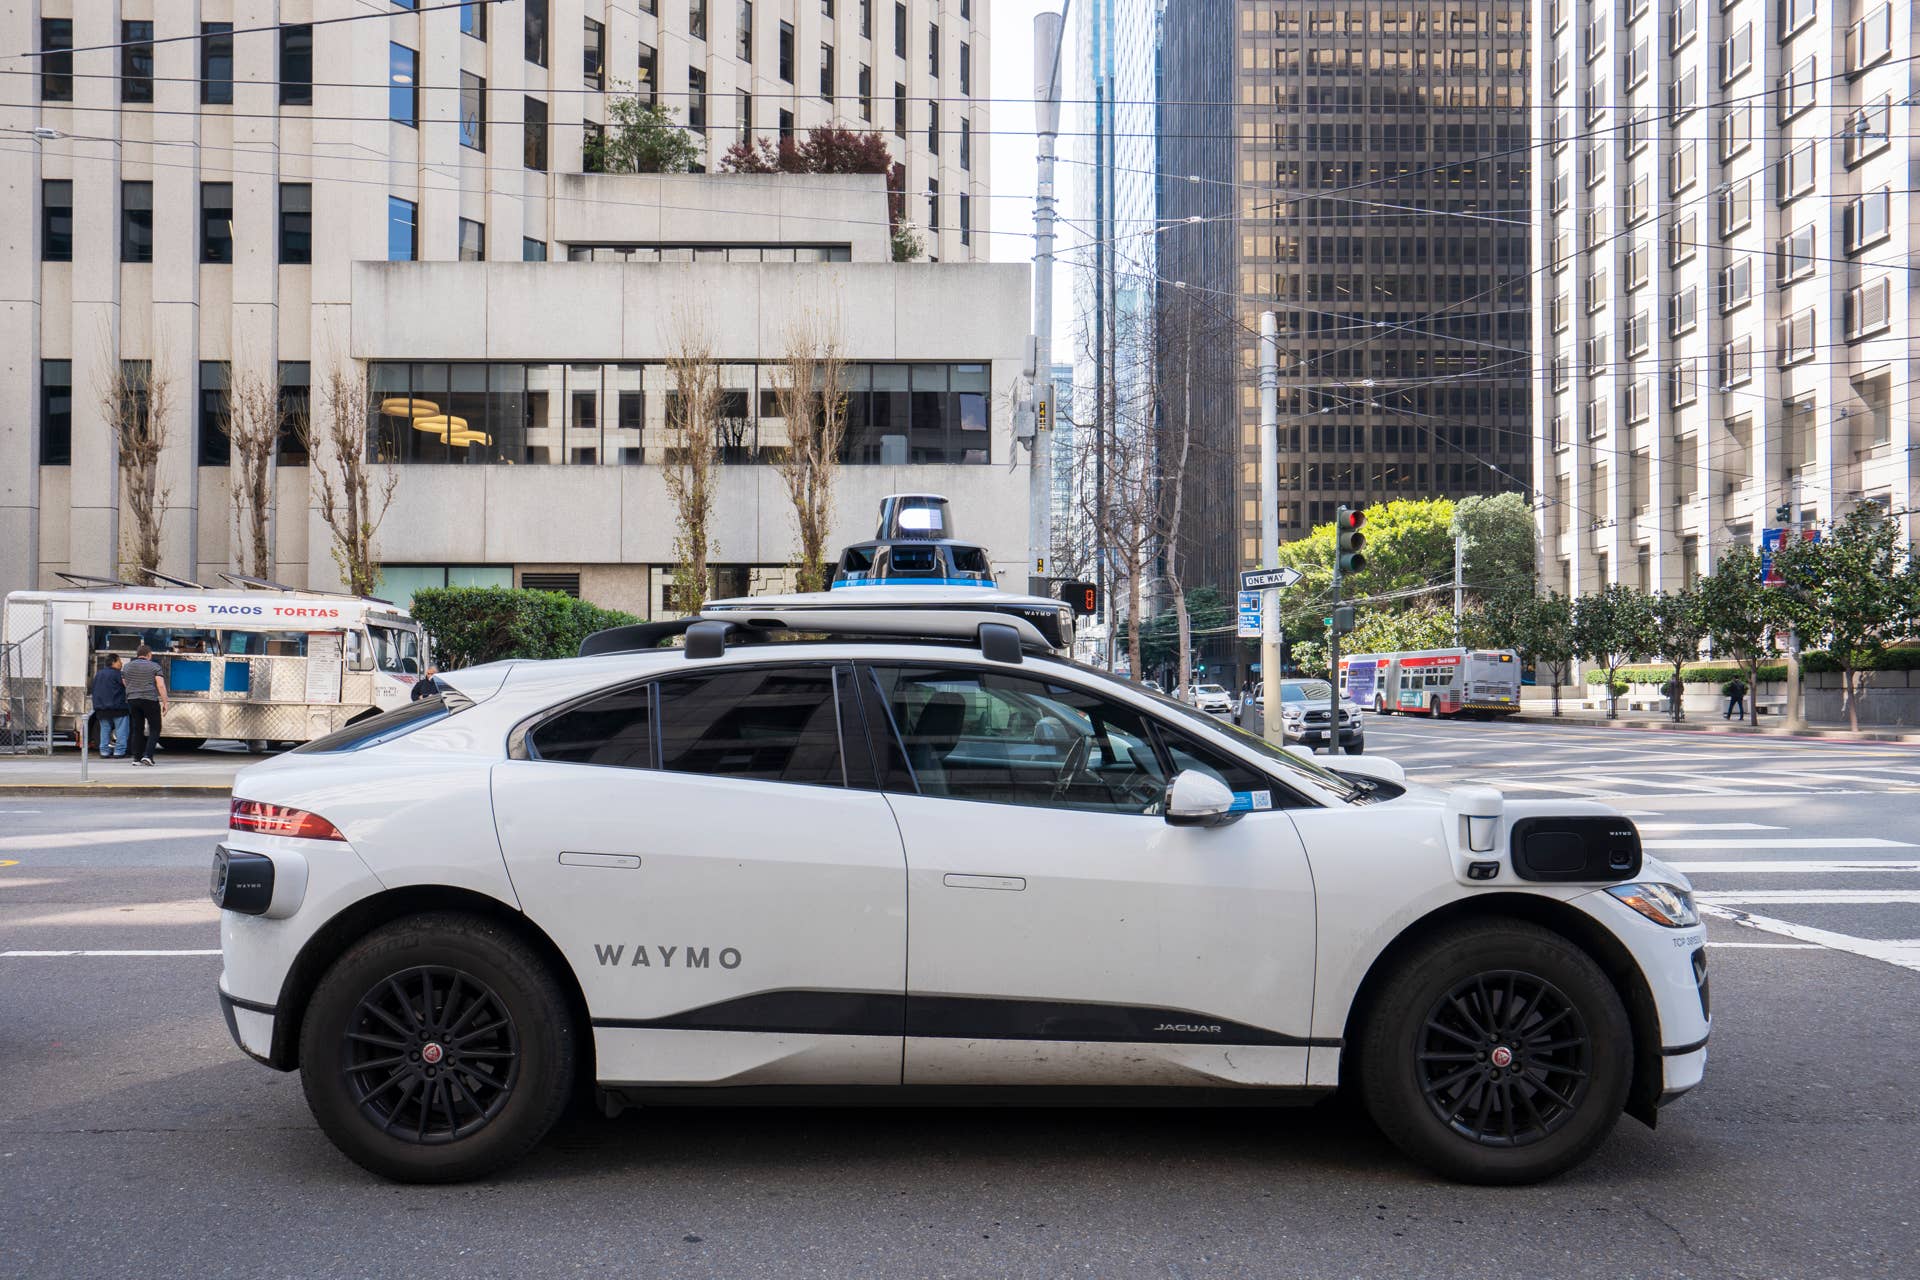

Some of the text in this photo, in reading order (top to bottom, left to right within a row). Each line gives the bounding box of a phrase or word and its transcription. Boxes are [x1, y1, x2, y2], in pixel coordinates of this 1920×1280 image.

[1247, 574, 1284, 585] ONE WAY
[112, 602, 339, 618] BURRITOS TACOS TORTAS
[594, 944, 742, 970] WAYMO
[1153, 1023, 1222, 1033] JAGUAR
